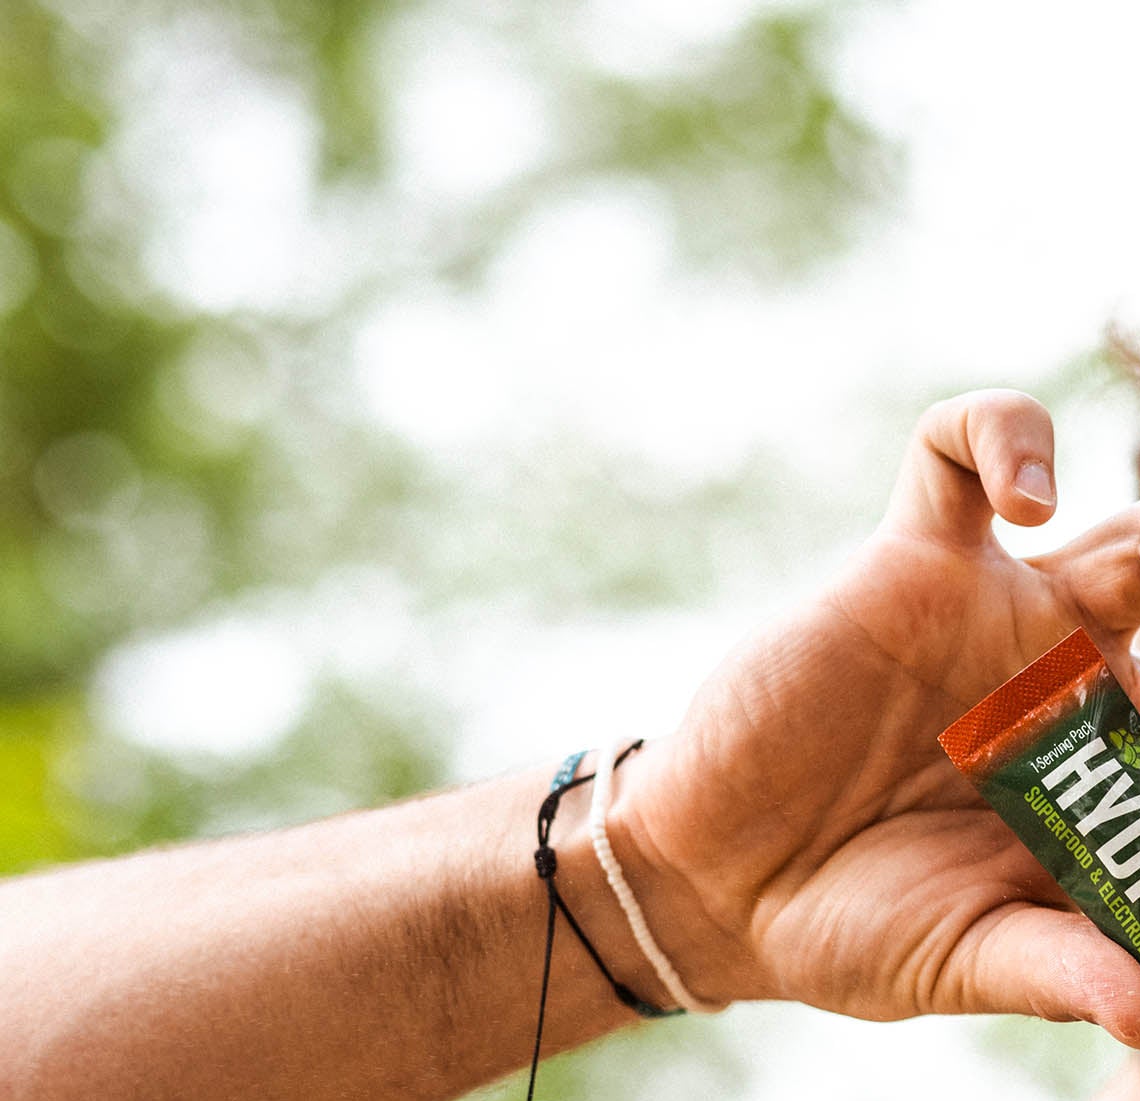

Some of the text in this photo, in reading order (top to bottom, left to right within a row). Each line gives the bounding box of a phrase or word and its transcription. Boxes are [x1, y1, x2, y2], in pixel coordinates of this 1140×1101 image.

[1030, 720, 1096, 774] 1-Serving Pack
[1023, 786, 1094, 869] SUPERFOOD
[1089, 868, 1104, 885] &
